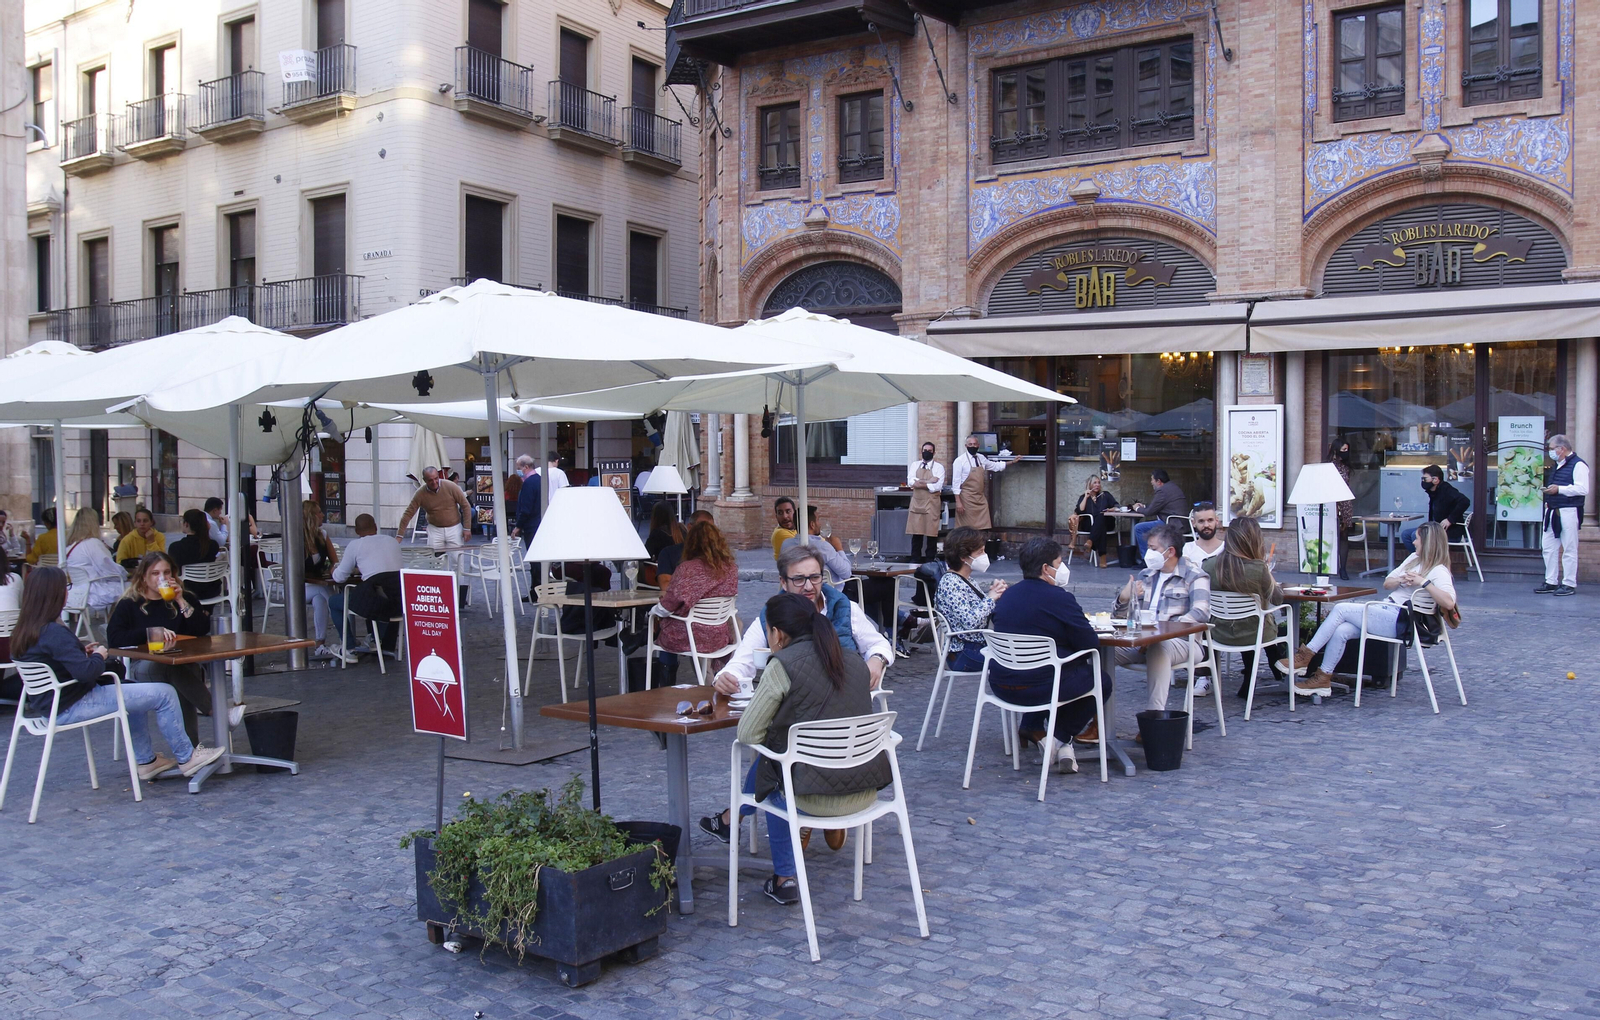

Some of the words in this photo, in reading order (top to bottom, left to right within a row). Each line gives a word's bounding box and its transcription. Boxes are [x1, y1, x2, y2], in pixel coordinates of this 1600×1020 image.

[1391, 223, 1437, 246] ROBLES
[1438, 223, 1490, 240] LAREDO
[362, 250, 393, 260] GRANADA
[1054, 249, 1094, 270] ROBLES
[1095, 248, 1138, 264] LAREDO
[1414, 242, 1462, 286] BAR
[1075, 266, 1115, 308] BAR
[416, 585, 441, 594] COCINA
[416, 594, 443, 604] ABIERTA
[410, 603, 428, 612] TODO
[438, 604, 450, 614] DÍA
